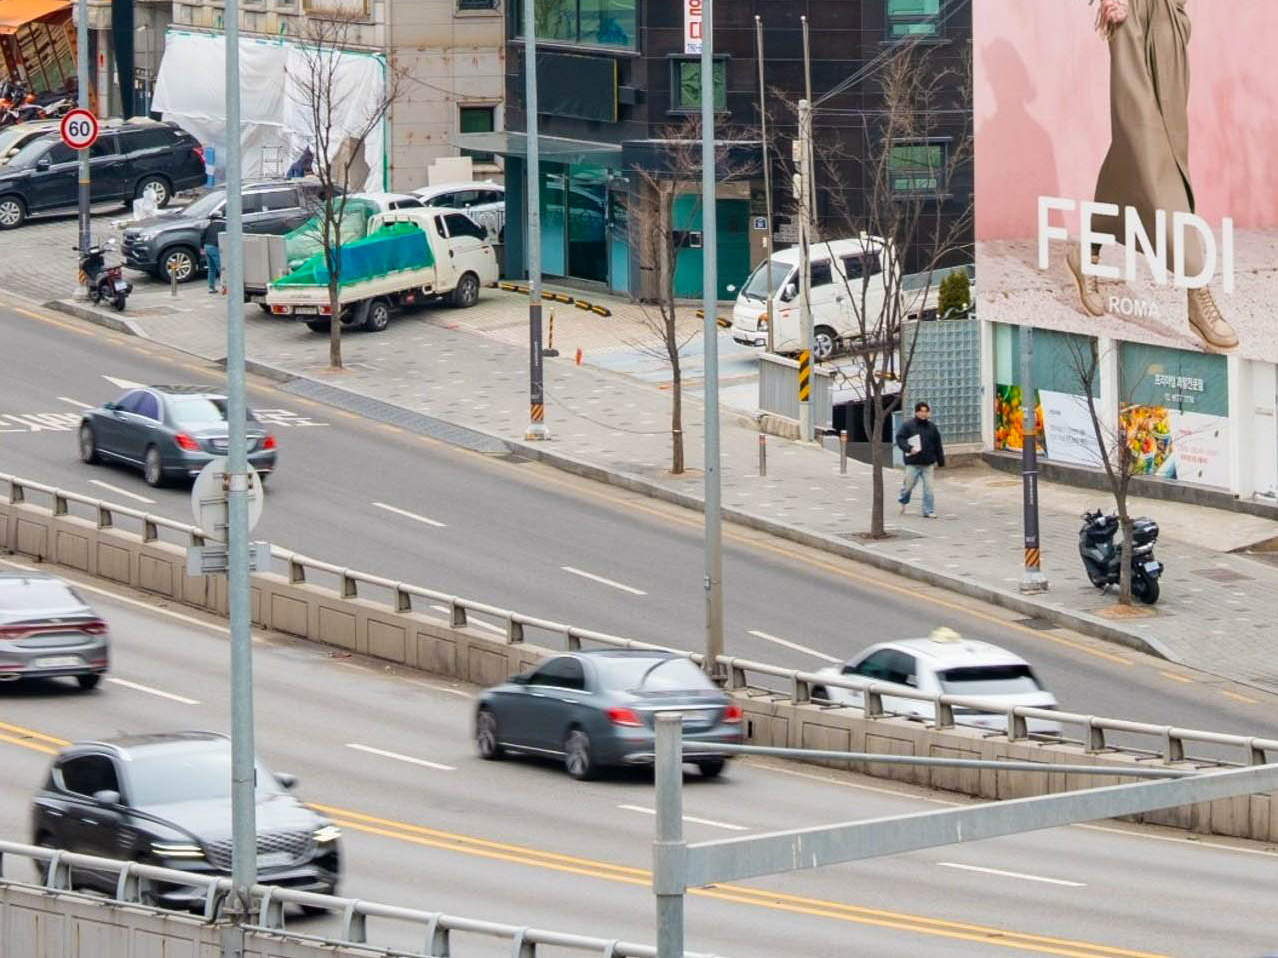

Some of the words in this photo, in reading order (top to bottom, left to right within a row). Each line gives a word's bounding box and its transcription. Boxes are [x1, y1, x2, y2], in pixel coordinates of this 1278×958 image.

[69, 120, 90, 137] 60
[1038, 195, 1234, 294] FENDI
[1108, 295, 1160, 318] ROMA
